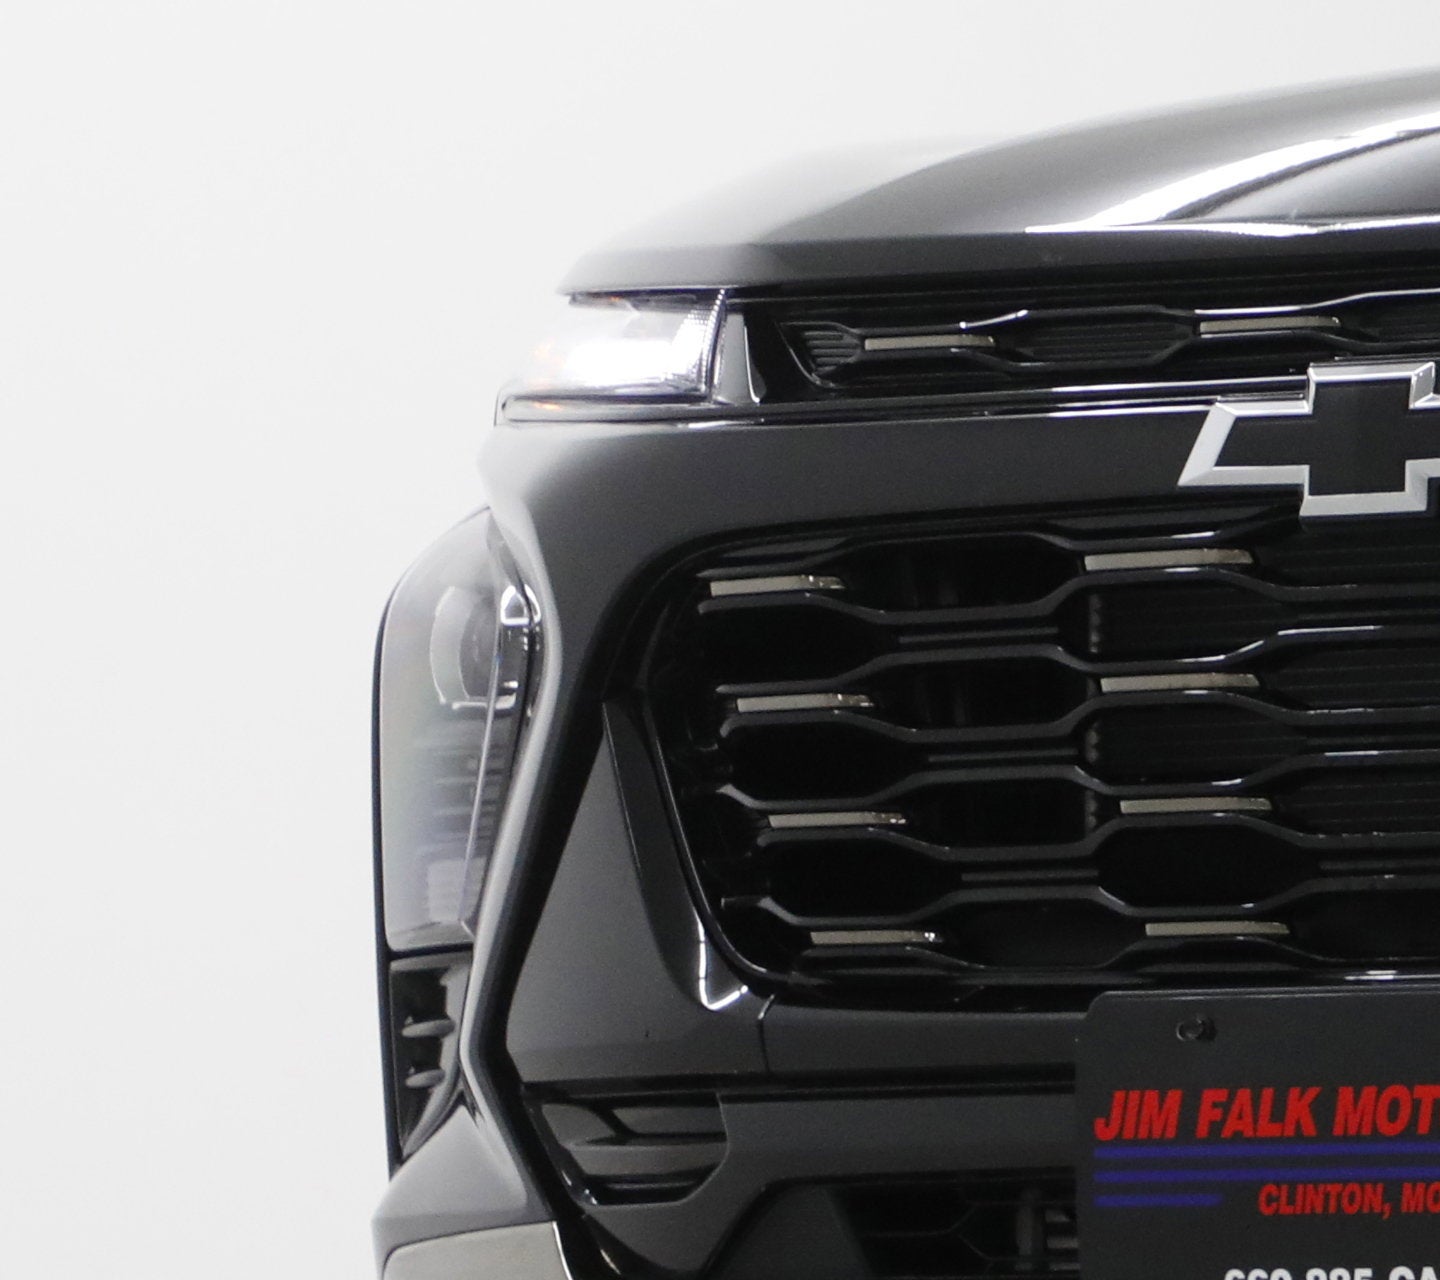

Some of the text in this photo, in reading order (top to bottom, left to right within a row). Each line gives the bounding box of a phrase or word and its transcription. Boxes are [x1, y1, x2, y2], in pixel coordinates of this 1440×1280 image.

[1094, 1088, 1184, 1141] JIM
[1195, 1086, 1322, 1140] FALK
[1258, 1182, 1394, 1220] CLINTON,
